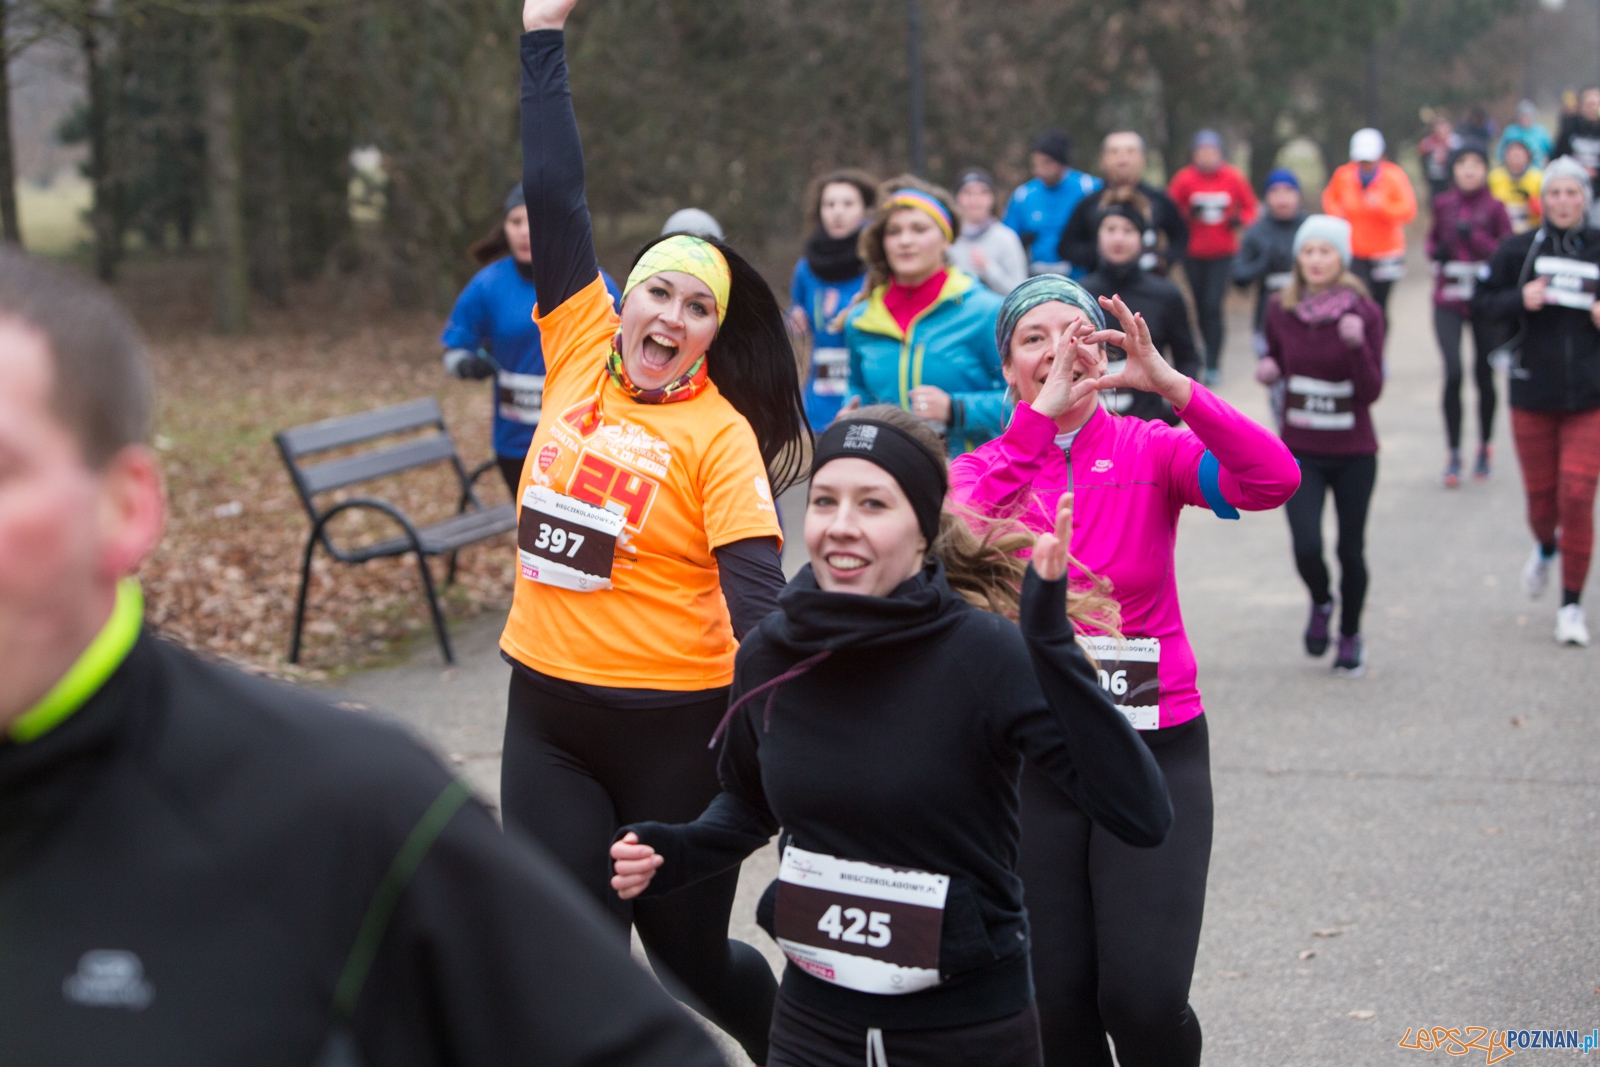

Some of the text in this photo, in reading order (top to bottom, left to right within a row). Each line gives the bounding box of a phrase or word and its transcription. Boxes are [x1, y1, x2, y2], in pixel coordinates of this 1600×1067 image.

[843, 440, 873, 451] RUN
[571, 453, 655, 526] 24
[555, 502, 617, 527] BIEGCZEKOLADOWY.PL
[534, 522, 585, 559] 397
[1097, 668, 1128, 696] 06
[839, 872, 938, 895] BIEGCZEKOLADOWY.PL
[817, 903, 892, 949] 425
